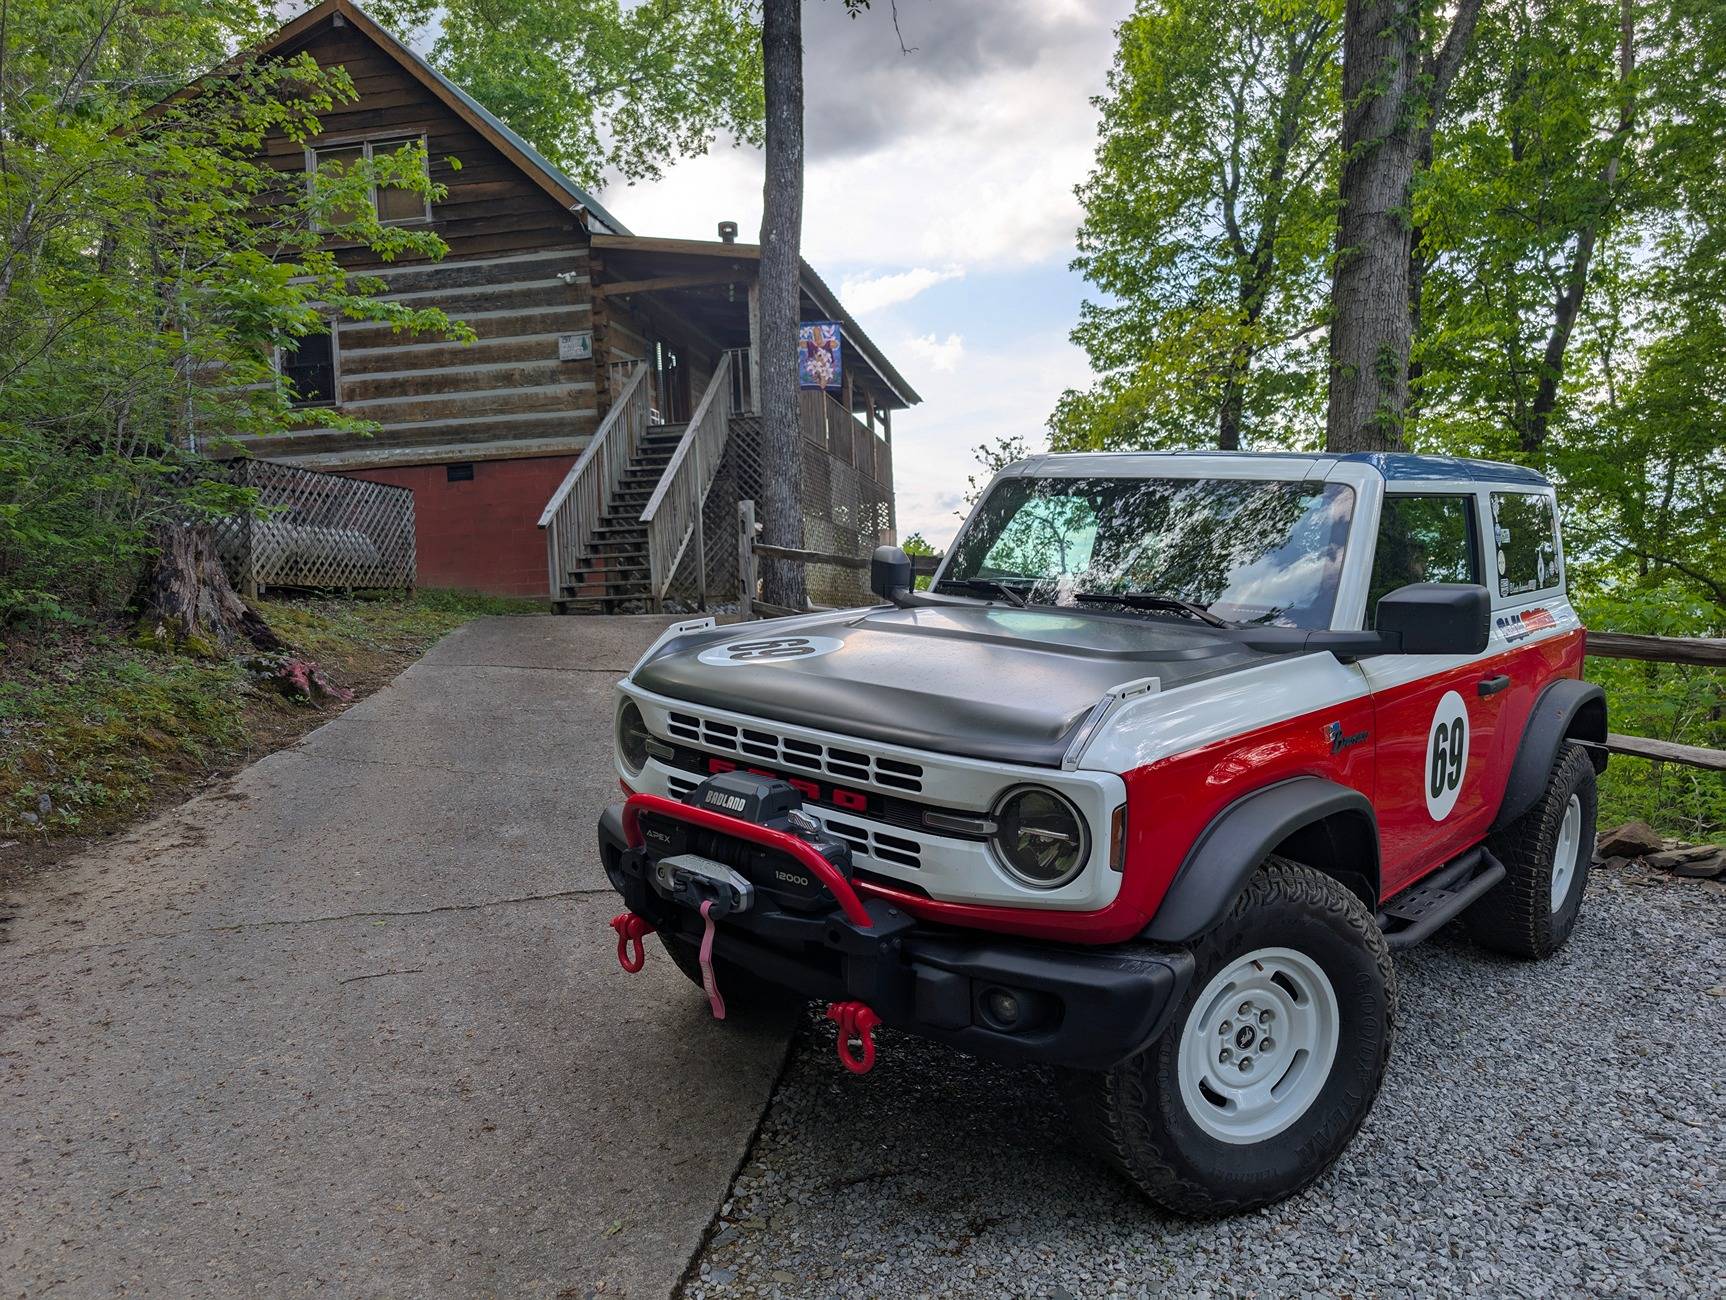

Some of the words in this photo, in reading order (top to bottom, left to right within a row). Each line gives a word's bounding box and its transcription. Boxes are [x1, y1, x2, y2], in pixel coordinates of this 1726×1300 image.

[1431, 716, 1464, 799] 69
[705, 790, 746, 813] BADLAND
[646, 829, 671, 844] APEX
[774, 870, 809, 886] 12000
